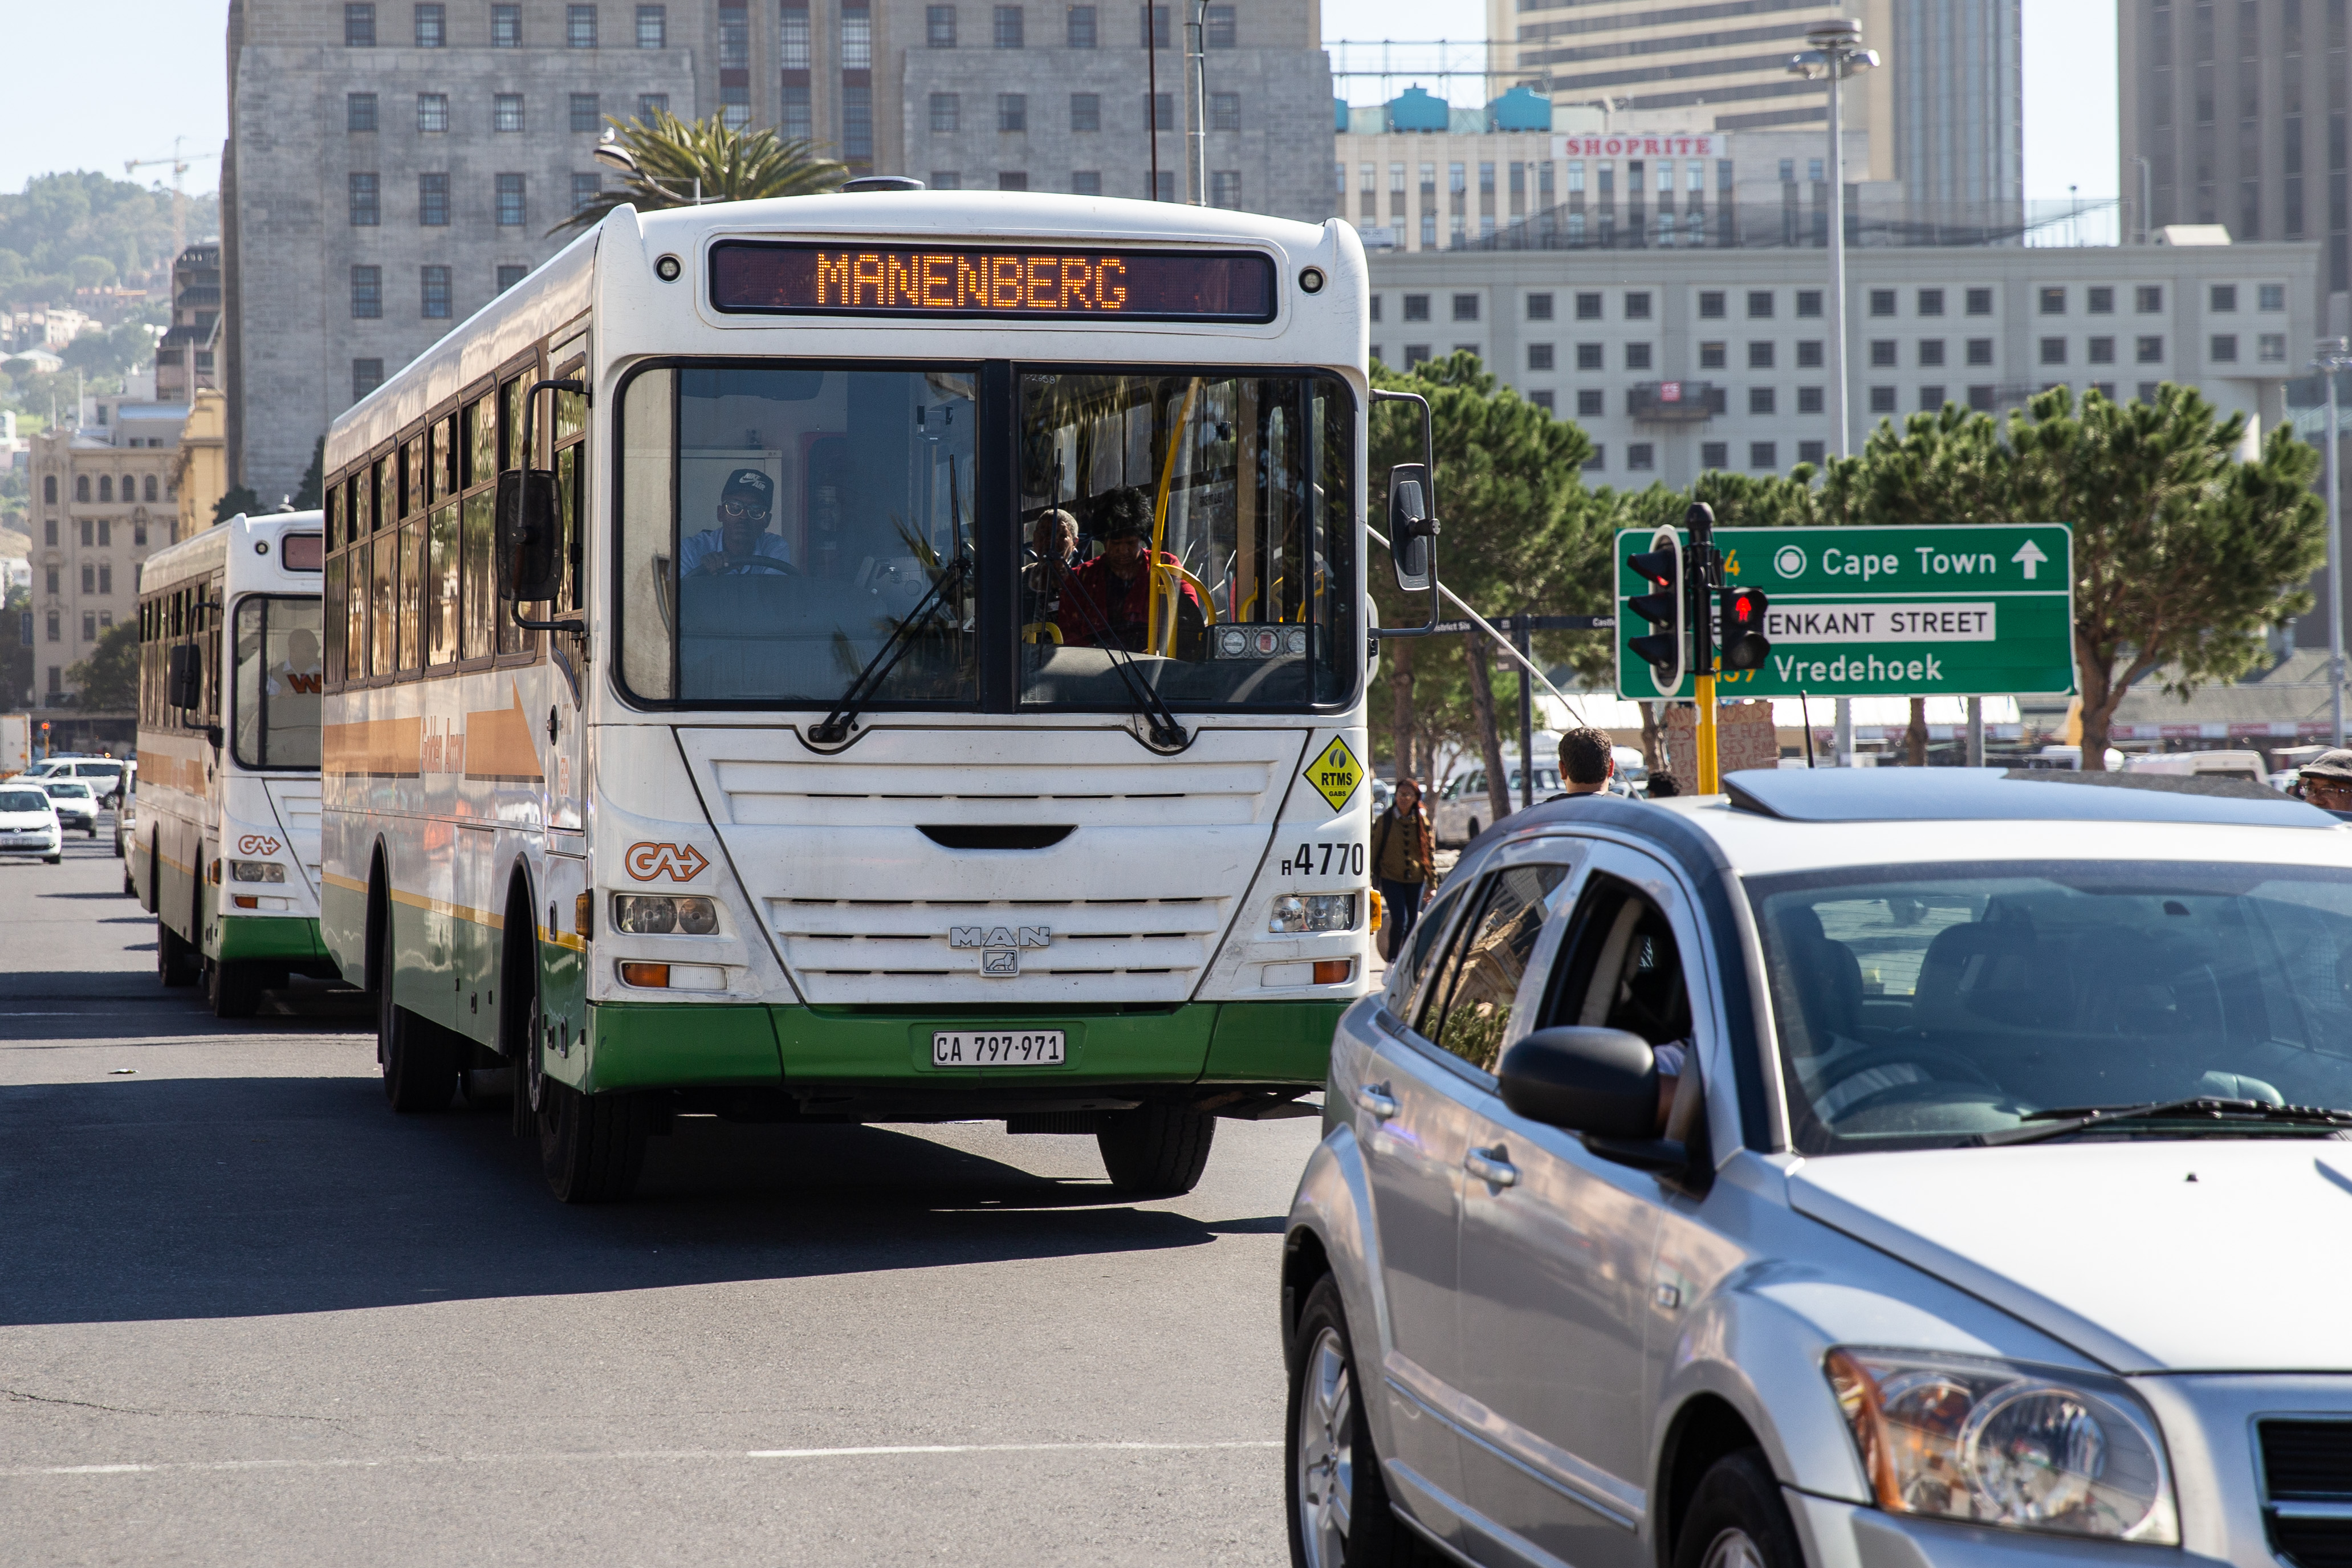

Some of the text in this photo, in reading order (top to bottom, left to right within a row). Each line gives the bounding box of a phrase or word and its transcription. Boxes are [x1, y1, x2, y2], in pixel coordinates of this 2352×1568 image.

[1566, 138, 1711, 156] SHOPRITE
[818, 254, 1126, 308] MANENBERG
[752, 481, 766, 491] AIR
[1823, 548, 1899, 581] Cape
[1914, 547, 1996, 575] Town
[1890, 612, 1988, 633] STREET
[1775, 653, 1943, 682] Vredehoek
[422, 715, 465, 773] Golden Arrow
[1321, 772, 1353, 786] RTMS
[950, 927, 1050, 947] MAN
[937, 1037, 962, 1061] CA
